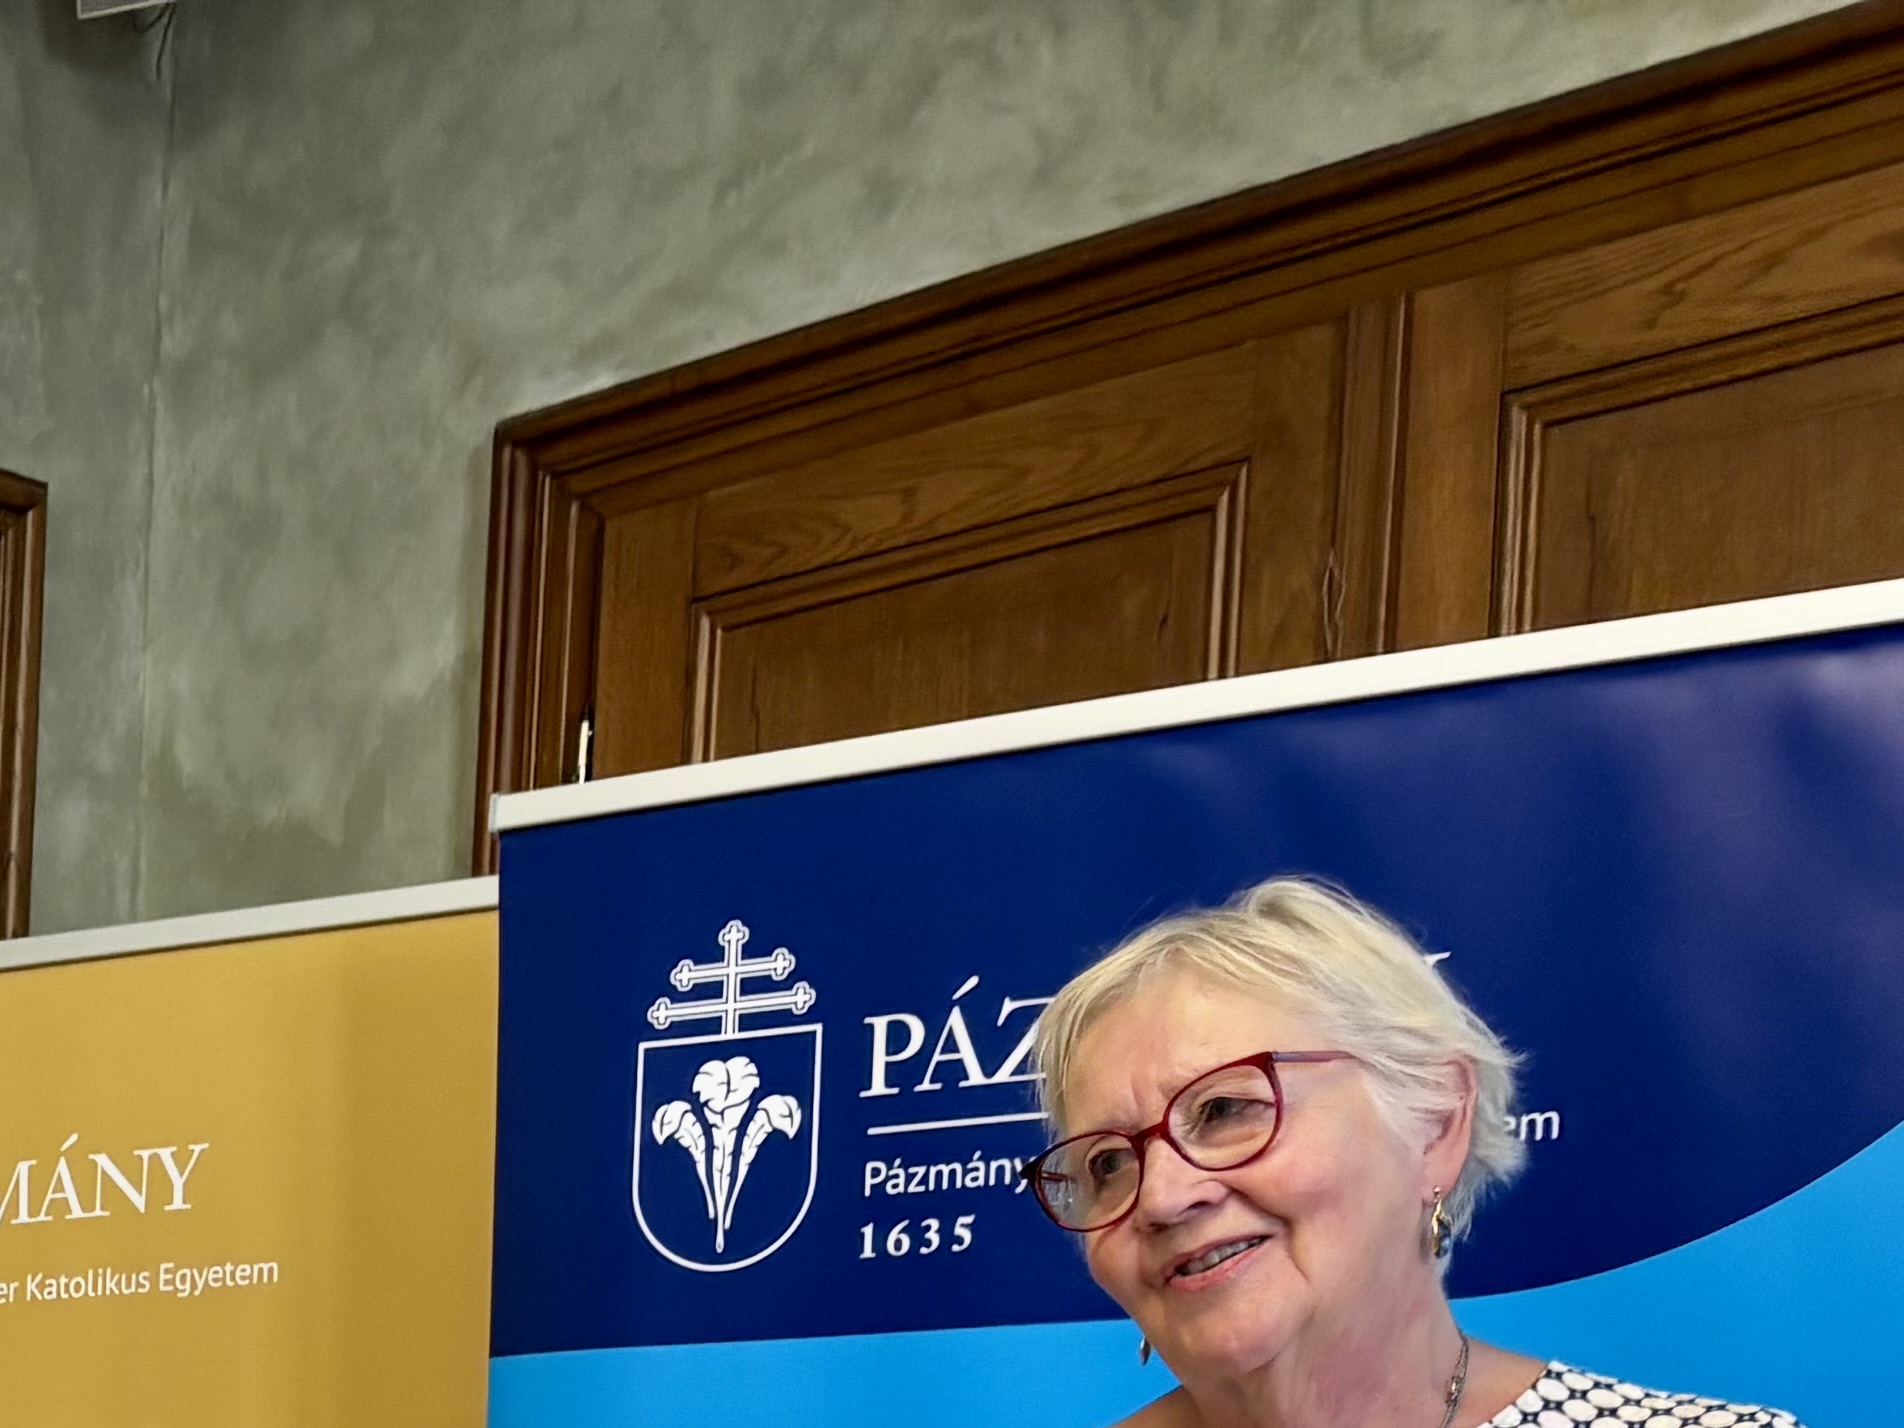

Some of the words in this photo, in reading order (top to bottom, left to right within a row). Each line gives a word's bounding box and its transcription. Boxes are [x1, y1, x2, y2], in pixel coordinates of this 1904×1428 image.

[859, 975, 1055, 1098] PÁZ
[859, 1214, 975, 1259] 1635
[25, 1264, 151, 1303] Katolikus
[159, 1256, 280, 1297] Egyetem
